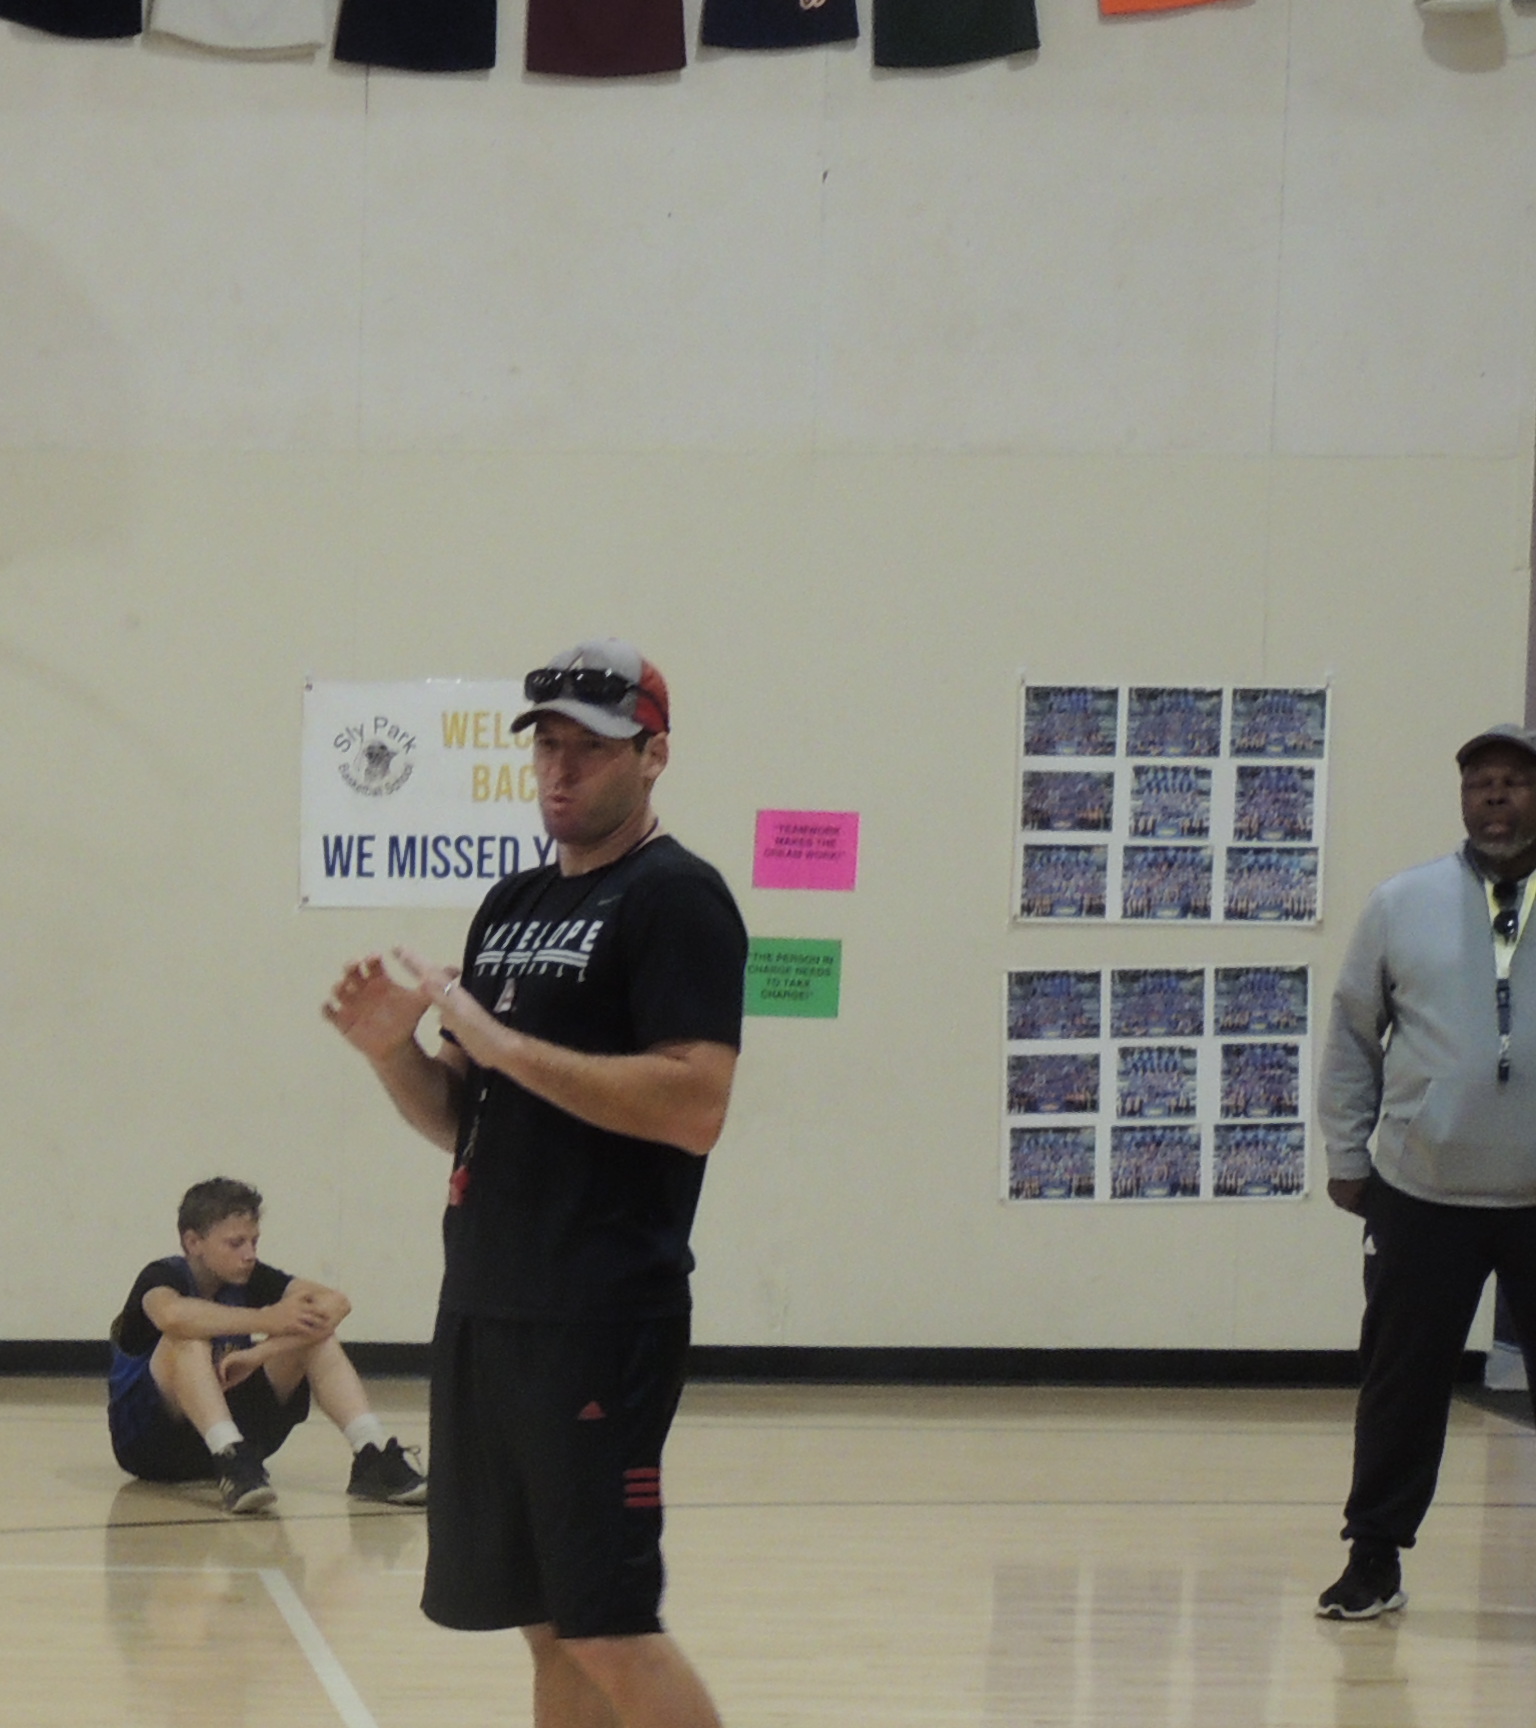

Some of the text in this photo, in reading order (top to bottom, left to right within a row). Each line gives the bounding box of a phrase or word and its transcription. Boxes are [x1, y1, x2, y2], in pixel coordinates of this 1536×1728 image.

[333, 715, 417, 755] Sly Park
[323, 835, 376, 878] WE
[388, 835, 520, 879] MISSED
